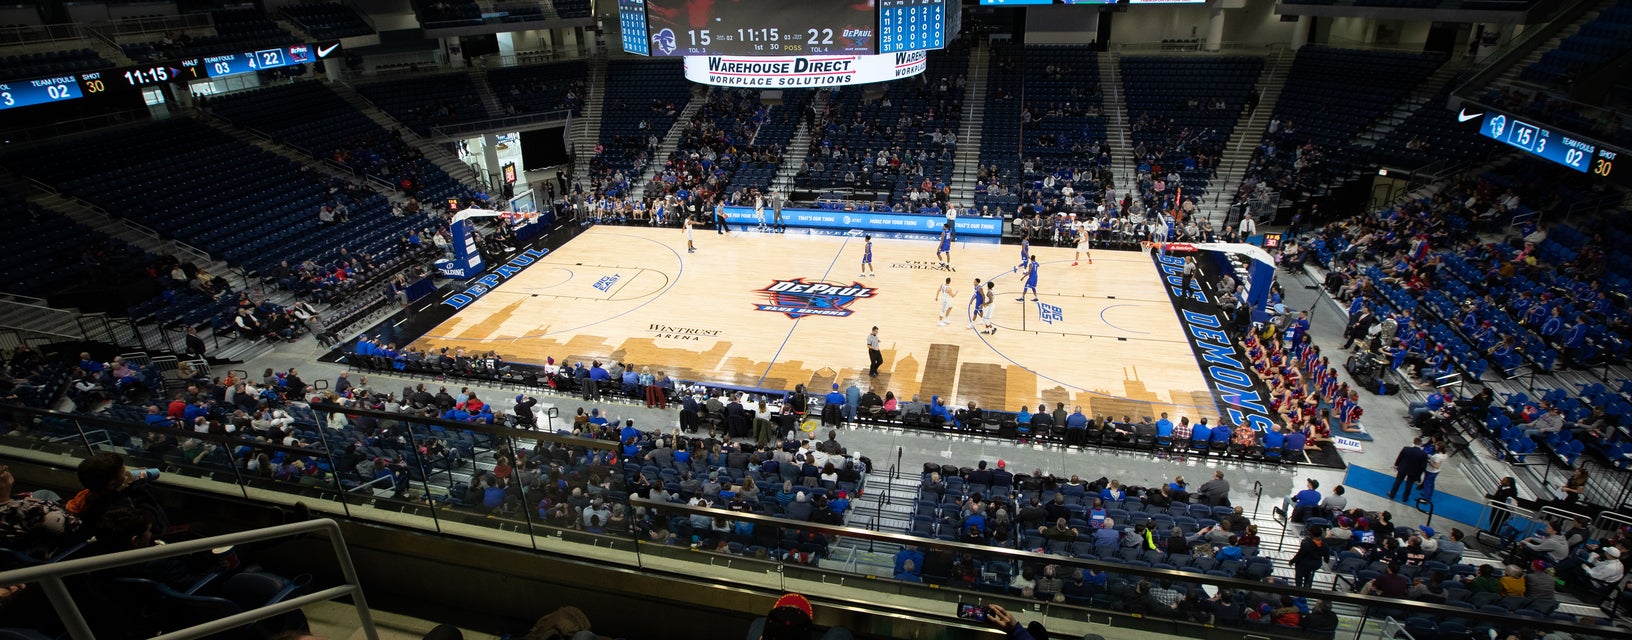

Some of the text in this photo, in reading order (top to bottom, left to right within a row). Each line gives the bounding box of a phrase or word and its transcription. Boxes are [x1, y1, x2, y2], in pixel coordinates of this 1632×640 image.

[688, 29, 711, 46] 15
[738, 28, 779, 42] 11:15
[807, 28, 833, 44] 22
[182, 59, 198, 67] HALF
[214, 52, 280, 75] 03 4 22
[708, 56, 851, 73] WAREHOUSE DIRECT
[31, 76, 76, 88] TEAM FOULS
[82, 72, 100, 80] SHOT
[124, 66, 197, 86] 11:15 1
[710, 75, 851, 85] WORKPLACE SOLUTIONS
[1, 80, 105, 106] 3 02 30
[1517, 127, 1550, 145] 15 TOL
[1537, 138, 1583, 167] 3 02
[1562, 137, 1595, 153] TEAM FOULS
[1598, 149, 1617, 160] SHOT
[1595, 159, 1612, 176] 30
[443, 248, 550, 310] DEPAUL
[593, 275, 610, 288] BIG
[768, 281, 871, 297] DEPAUL
[1041, 303, 1052, 325] EAST
[1051, 305, 1063, 321] BIG
[649, 324, 722, 336] WINTRUST
[1182, 308, 1274, 434] DEMONS
[1338, 438, 1360, 448] BLUE
